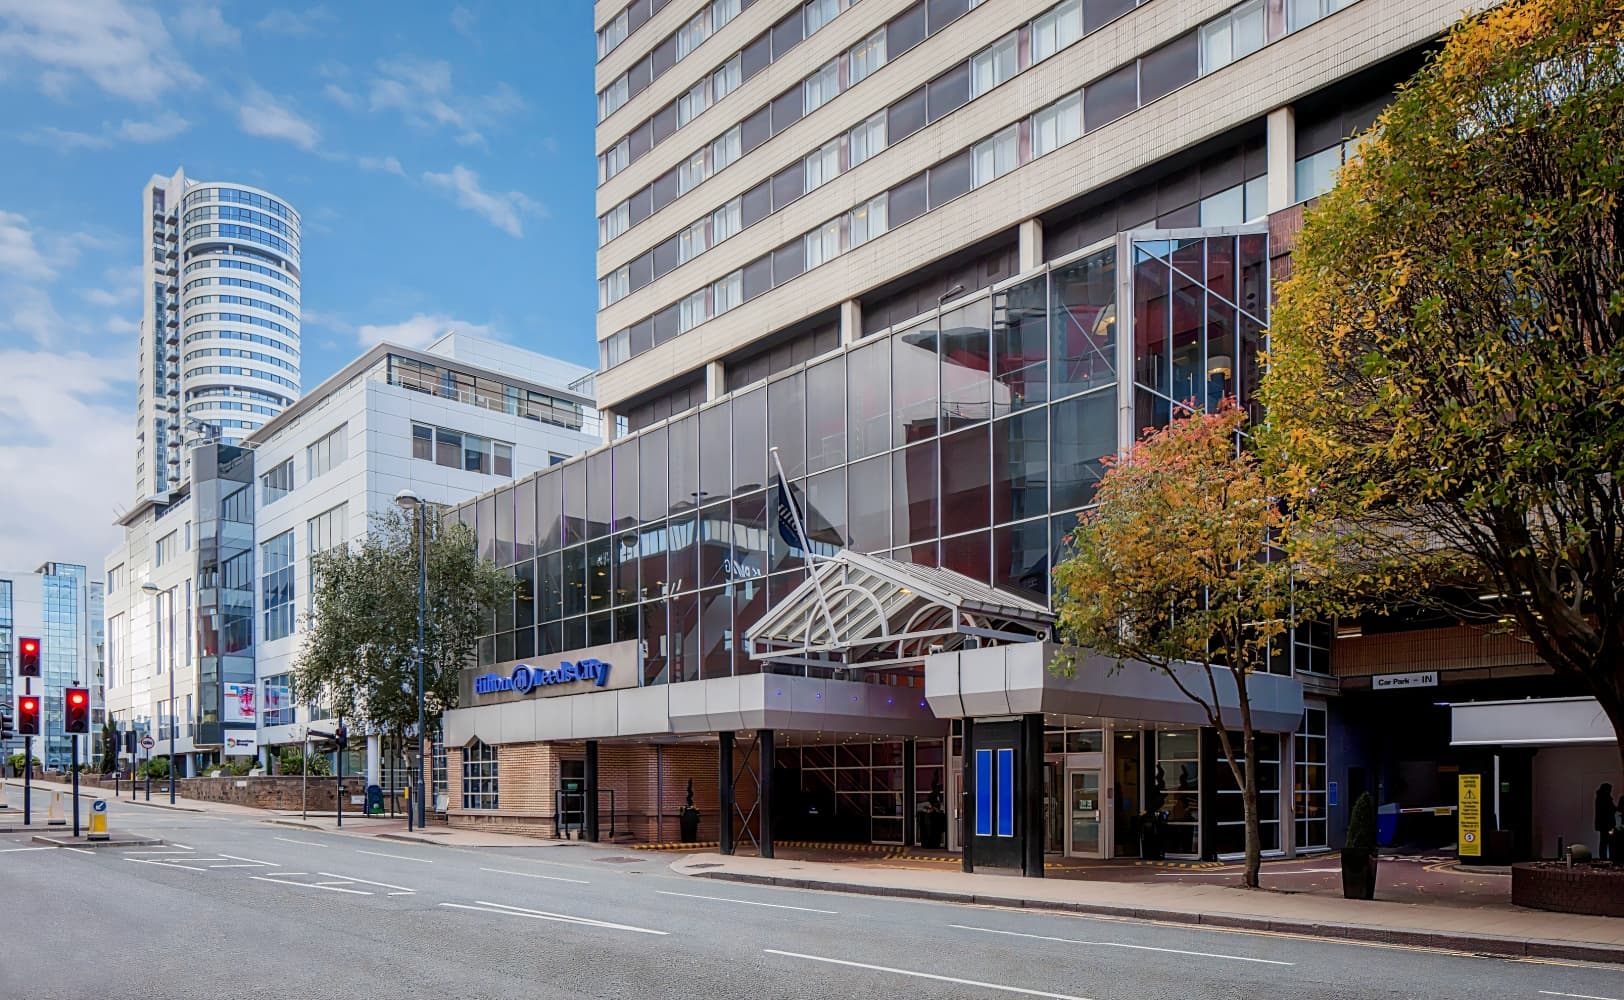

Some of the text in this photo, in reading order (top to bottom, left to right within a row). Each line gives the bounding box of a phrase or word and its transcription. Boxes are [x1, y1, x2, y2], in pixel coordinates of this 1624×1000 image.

[475, 659, 611, 694] Hilton Leeds City
[1393, 677, 1410, 685] Park
[1422, 674, 1433, 684] IN
